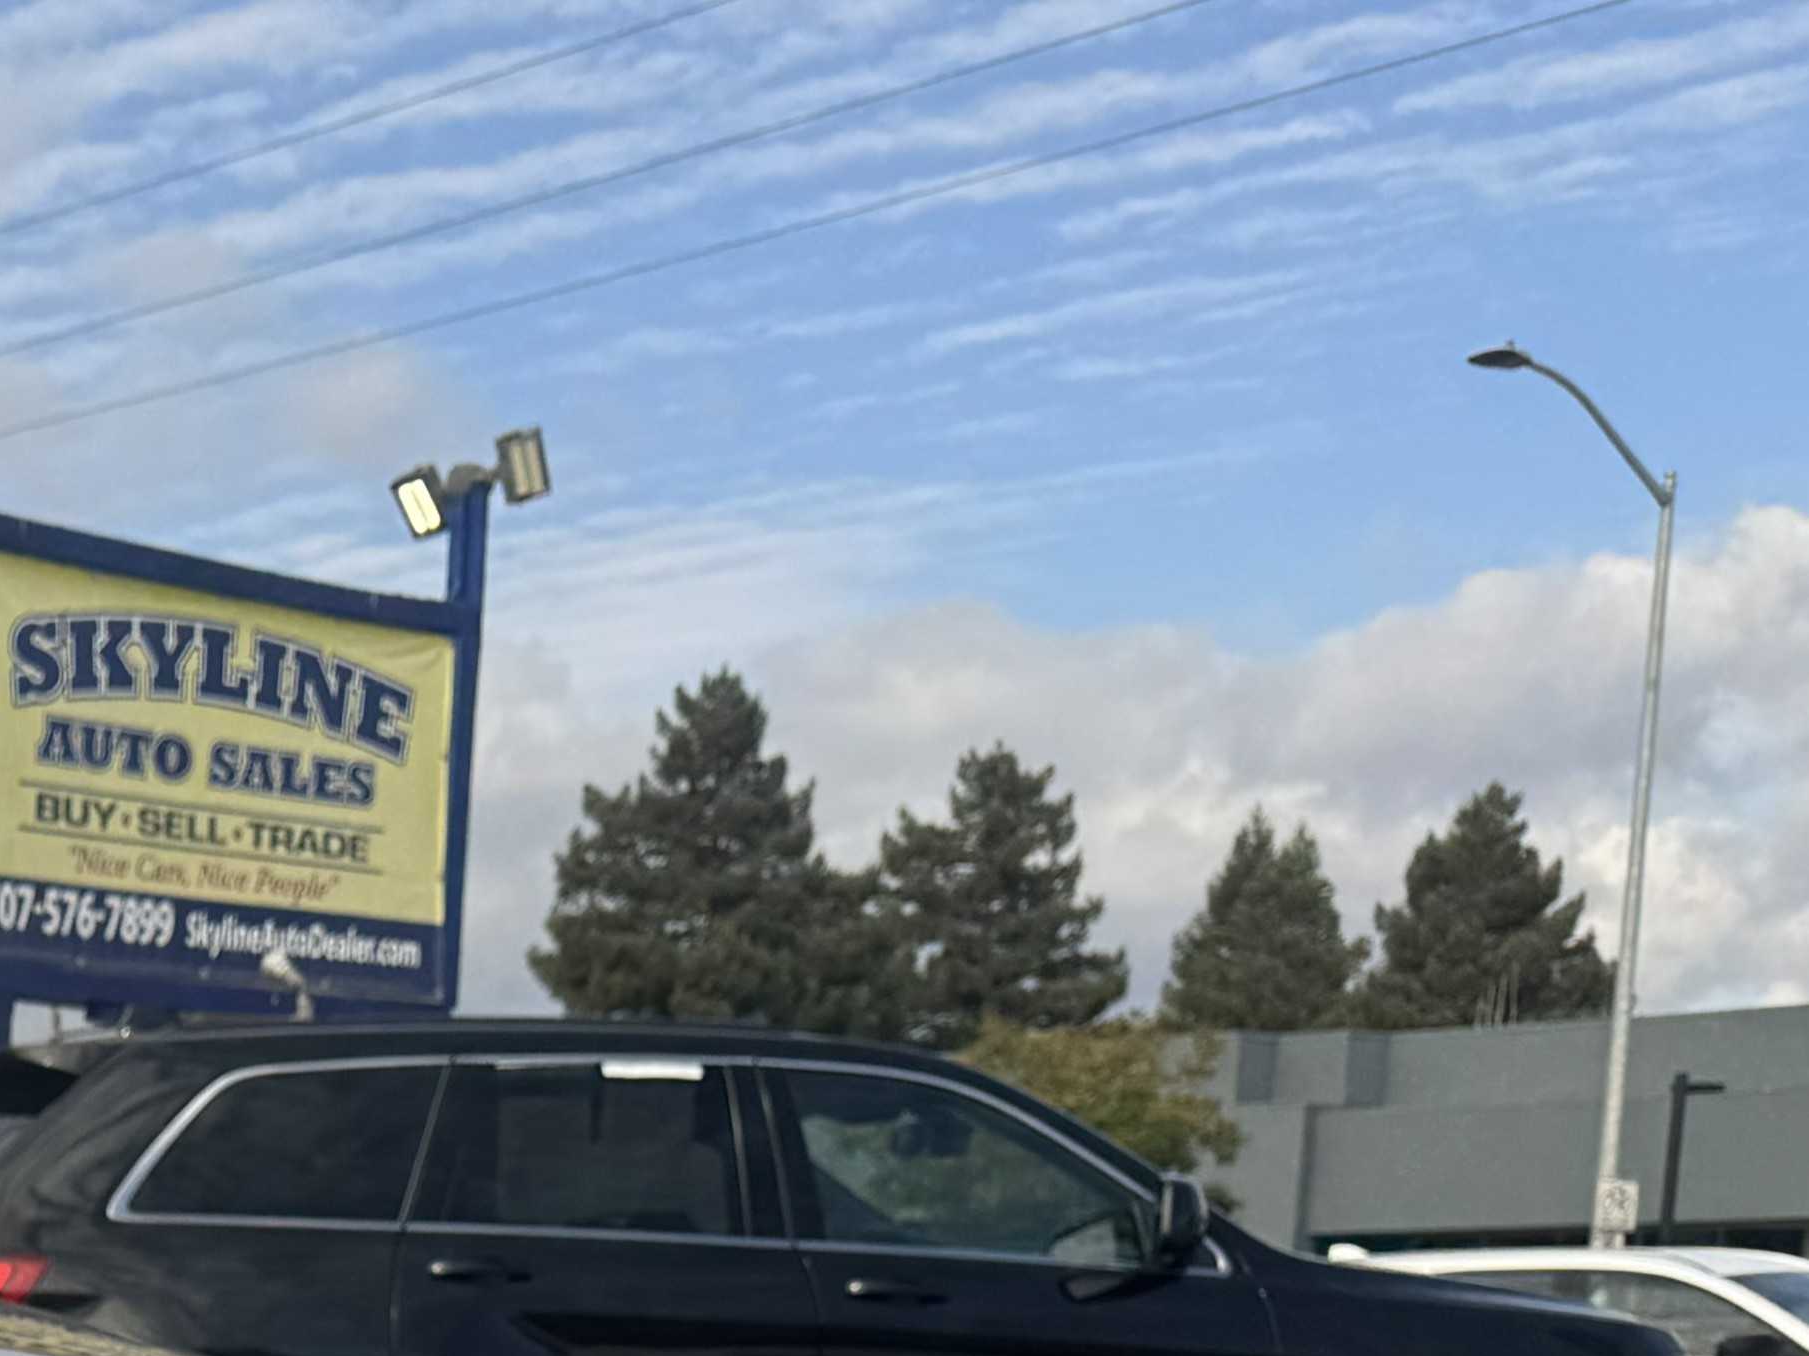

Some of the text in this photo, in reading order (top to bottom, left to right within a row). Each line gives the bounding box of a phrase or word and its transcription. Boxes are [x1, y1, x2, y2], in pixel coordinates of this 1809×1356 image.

[8, 611, 415, 766] SKYLINE
[36, 714, 377, 810] AUTO SALES
[35, 792, 369, 863] BUY SELL TRADE
[68, 845, 130, 880] "Nice
[197, 863, 249, 895] Nice
[253, 868, 340, 908] People"
[184, 910, 422, 969] SkylineAutoDealer.com
